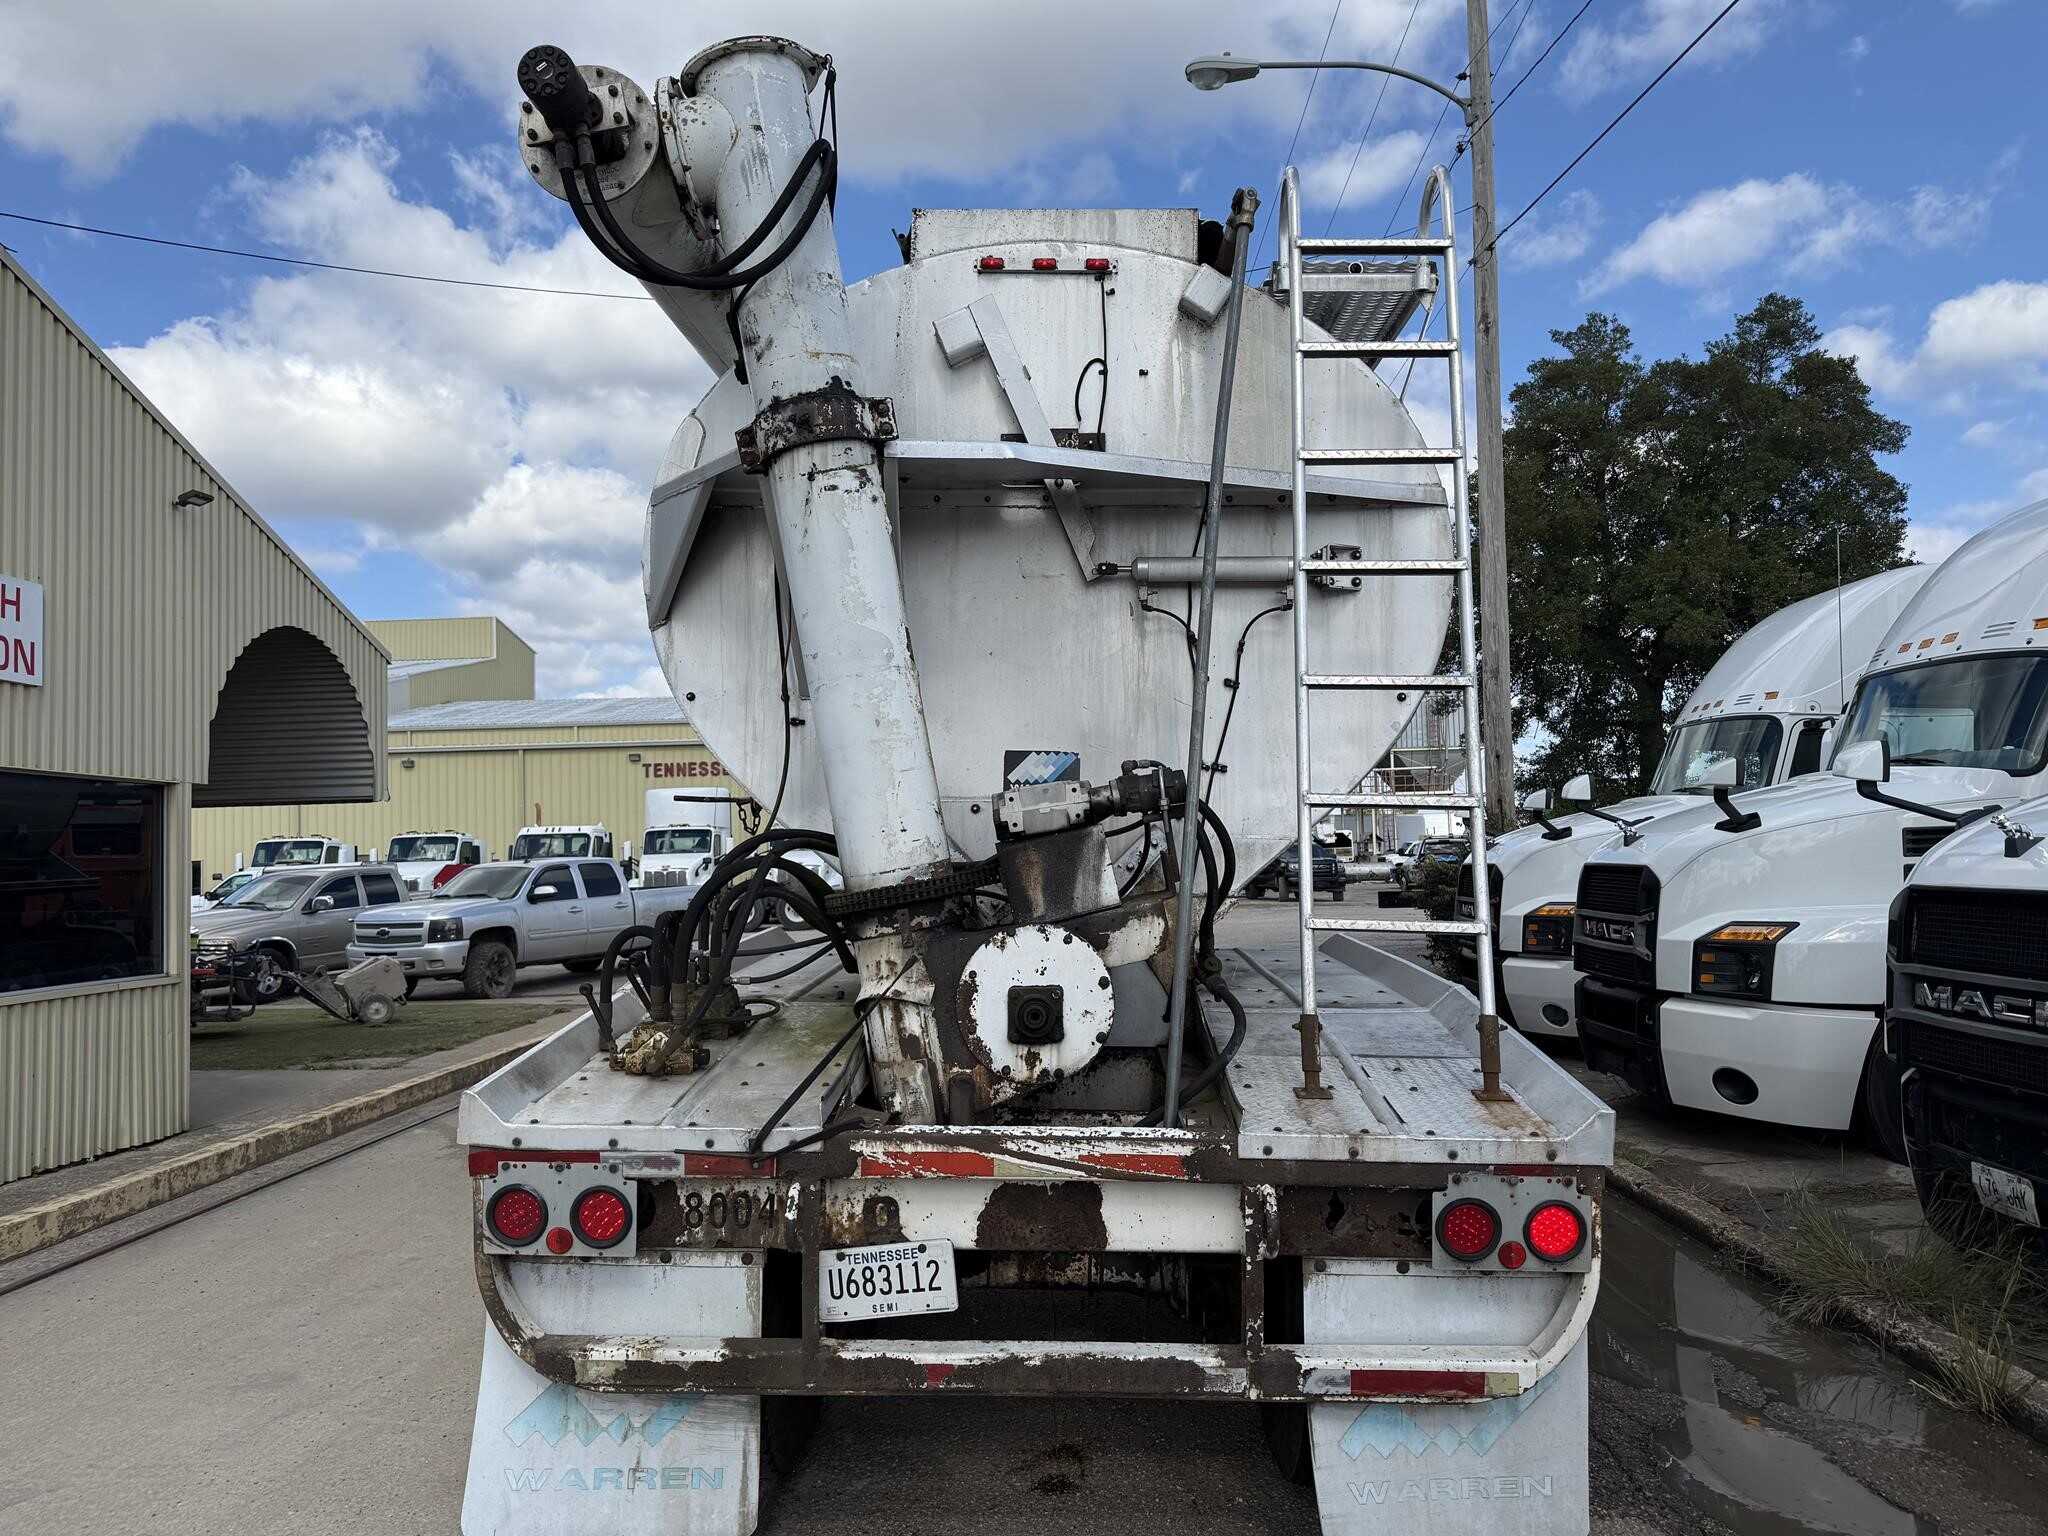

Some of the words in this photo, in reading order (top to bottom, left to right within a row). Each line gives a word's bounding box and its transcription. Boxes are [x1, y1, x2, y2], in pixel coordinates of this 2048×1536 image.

[845, 1247, 919, 1265] TENNESSEE
[828, 1259, 942, 1300] U683112
[872, 1302, 899, 1313] SEMI
[503, 1467, 725, 1492] WARREN
[1346, 1475, 1553, 1505] WARREN
